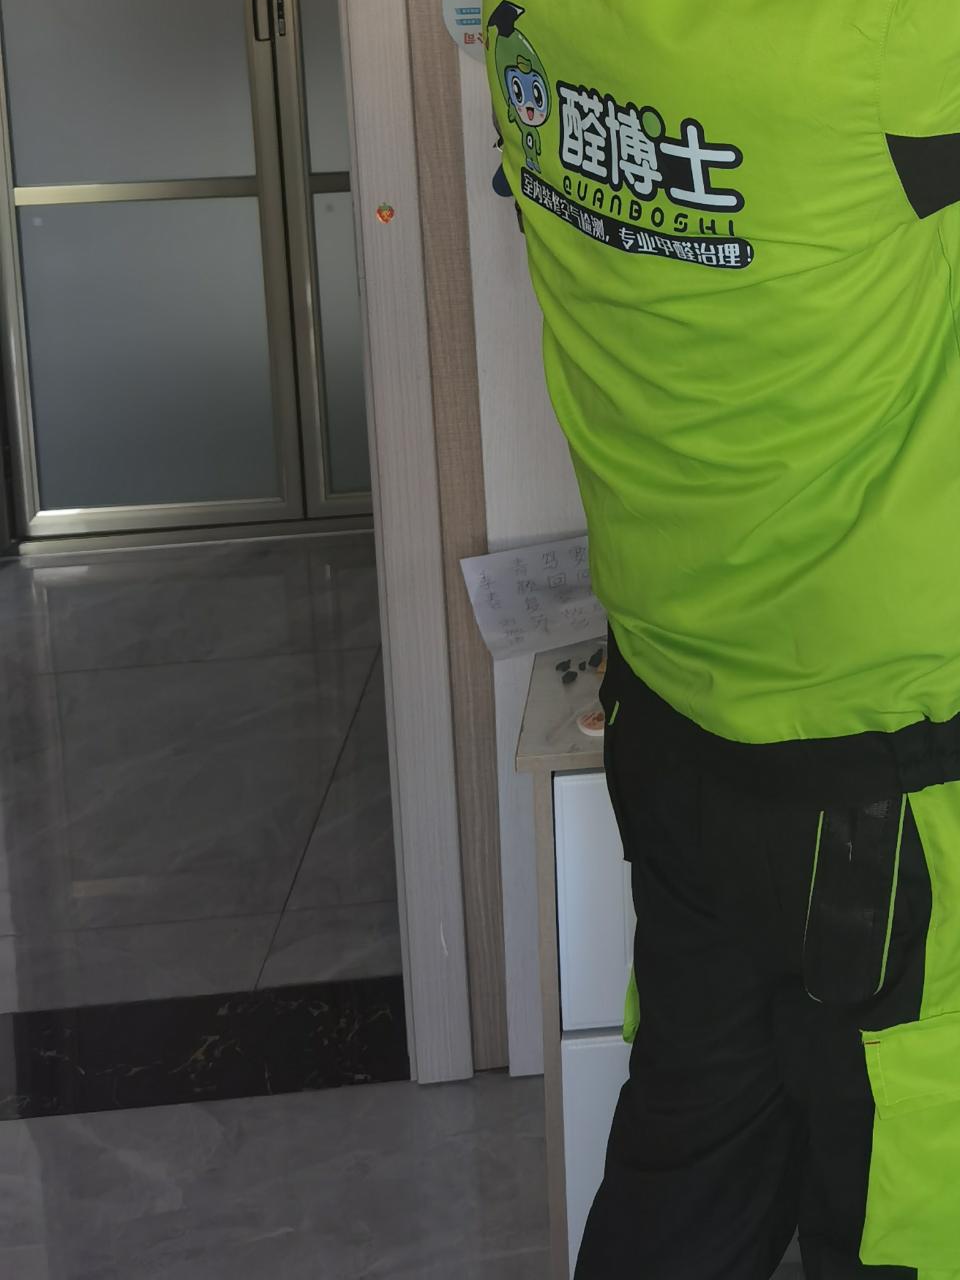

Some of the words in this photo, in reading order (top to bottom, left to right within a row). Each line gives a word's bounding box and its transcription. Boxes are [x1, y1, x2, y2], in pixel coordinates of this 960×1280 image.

[558, 84, 741, 209] 醛博士
[563, 175, 735, 236] QUANBOSHI
